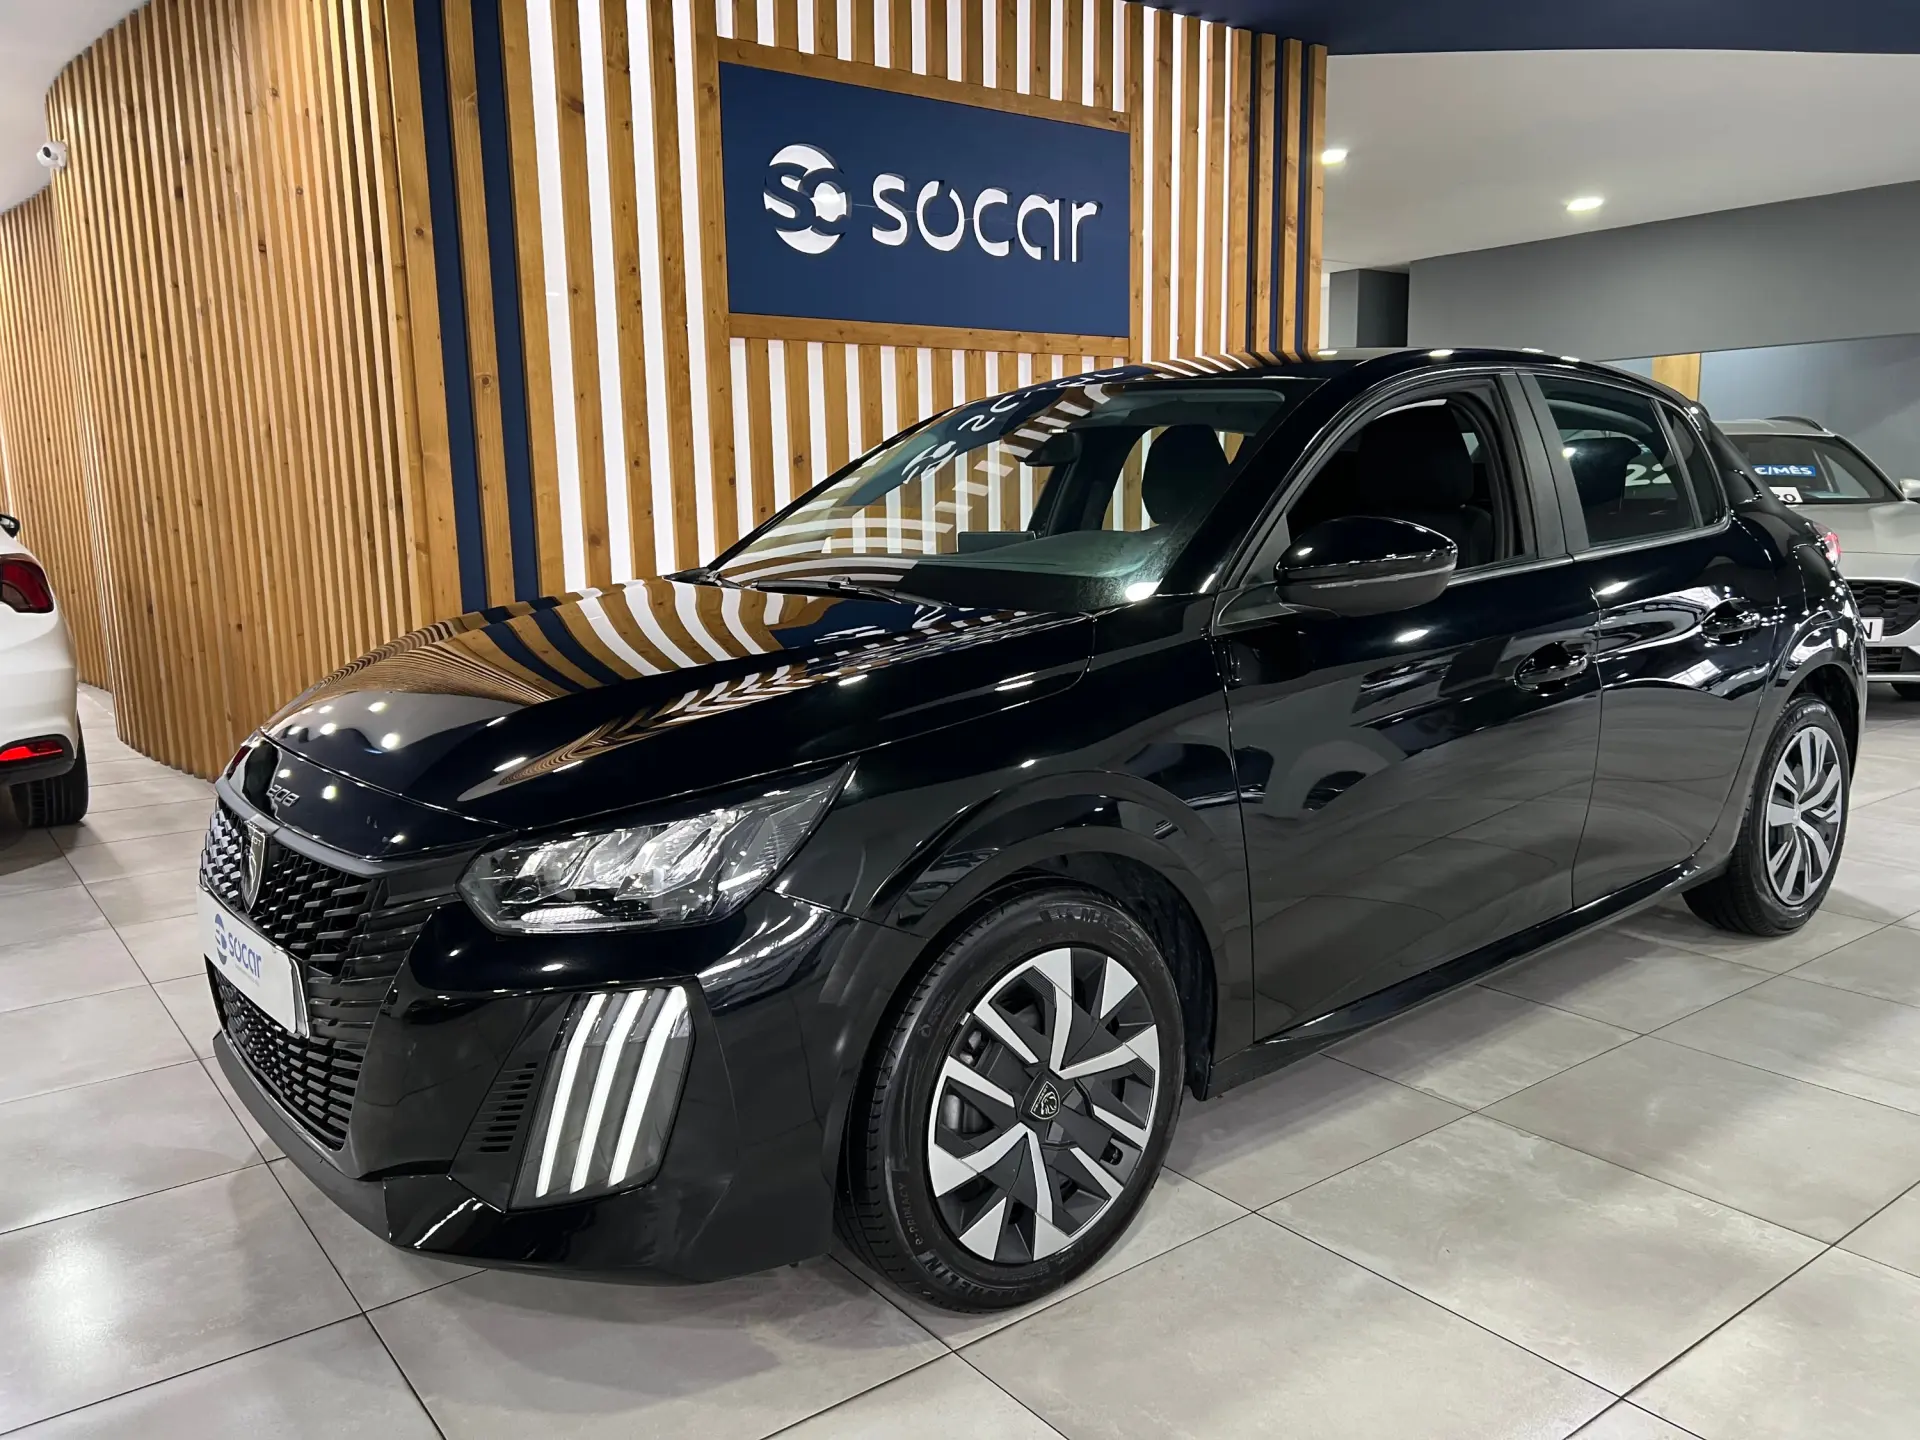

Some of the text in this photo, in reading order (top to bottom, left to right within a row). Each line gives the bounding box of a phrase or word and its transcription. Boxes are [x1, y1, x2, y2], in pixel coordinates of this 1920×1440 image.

[872, 173, 1100, 262] socar
[266, 784, 300, 807] 208
[228, 932, 262, 978] socar
